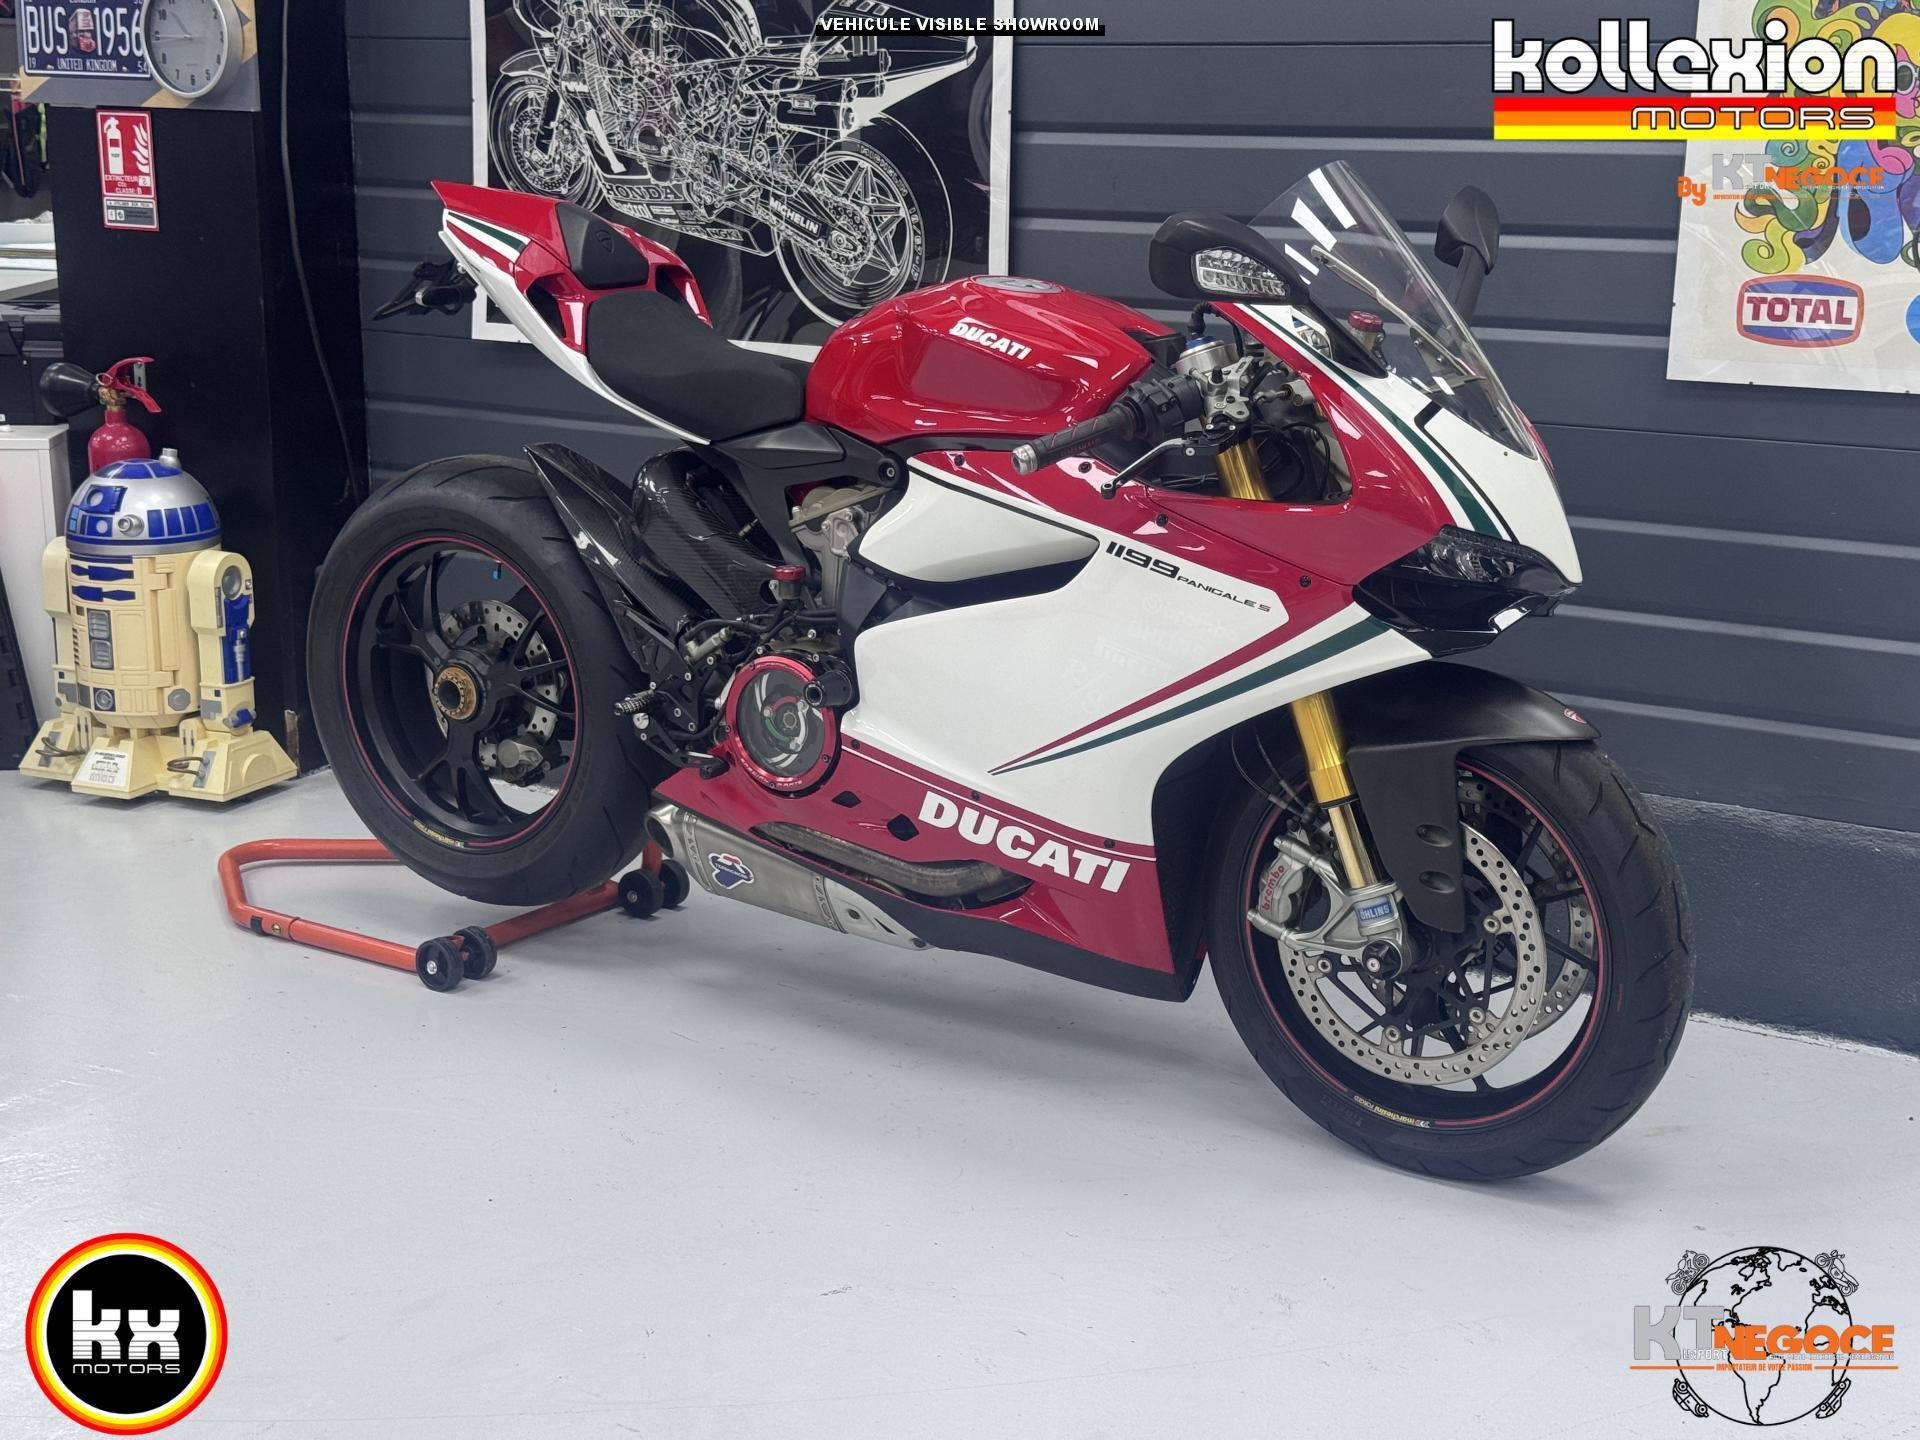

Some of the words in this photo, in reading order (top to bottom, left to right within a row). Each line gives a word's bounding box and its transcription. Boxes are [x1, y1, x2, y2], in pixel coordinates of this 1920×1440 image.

[26, 6, 68, 54] BUS
[94, 7, 144, 57] 1956
[29, 57, 36, 68] 19
[57, 58, 84, 70] UNITED
[86, 59, 118, 72] KINGDOM
[604, 182, 683, 201] HONDA
[770, 198, 819, 235] MICHELIN
[1747, 296, 1853, 325] TOTAL
[949, 322, 1032, 360] DUCATI
[1106, 541, 1180, 579] 1199
[1177, 575, 1256, 608] PANIGALE
[1257, 604, 1272, 612] S
[918, 790, 1131, 893] DUCATI
[1261, 864, 1285, 911] brembo
